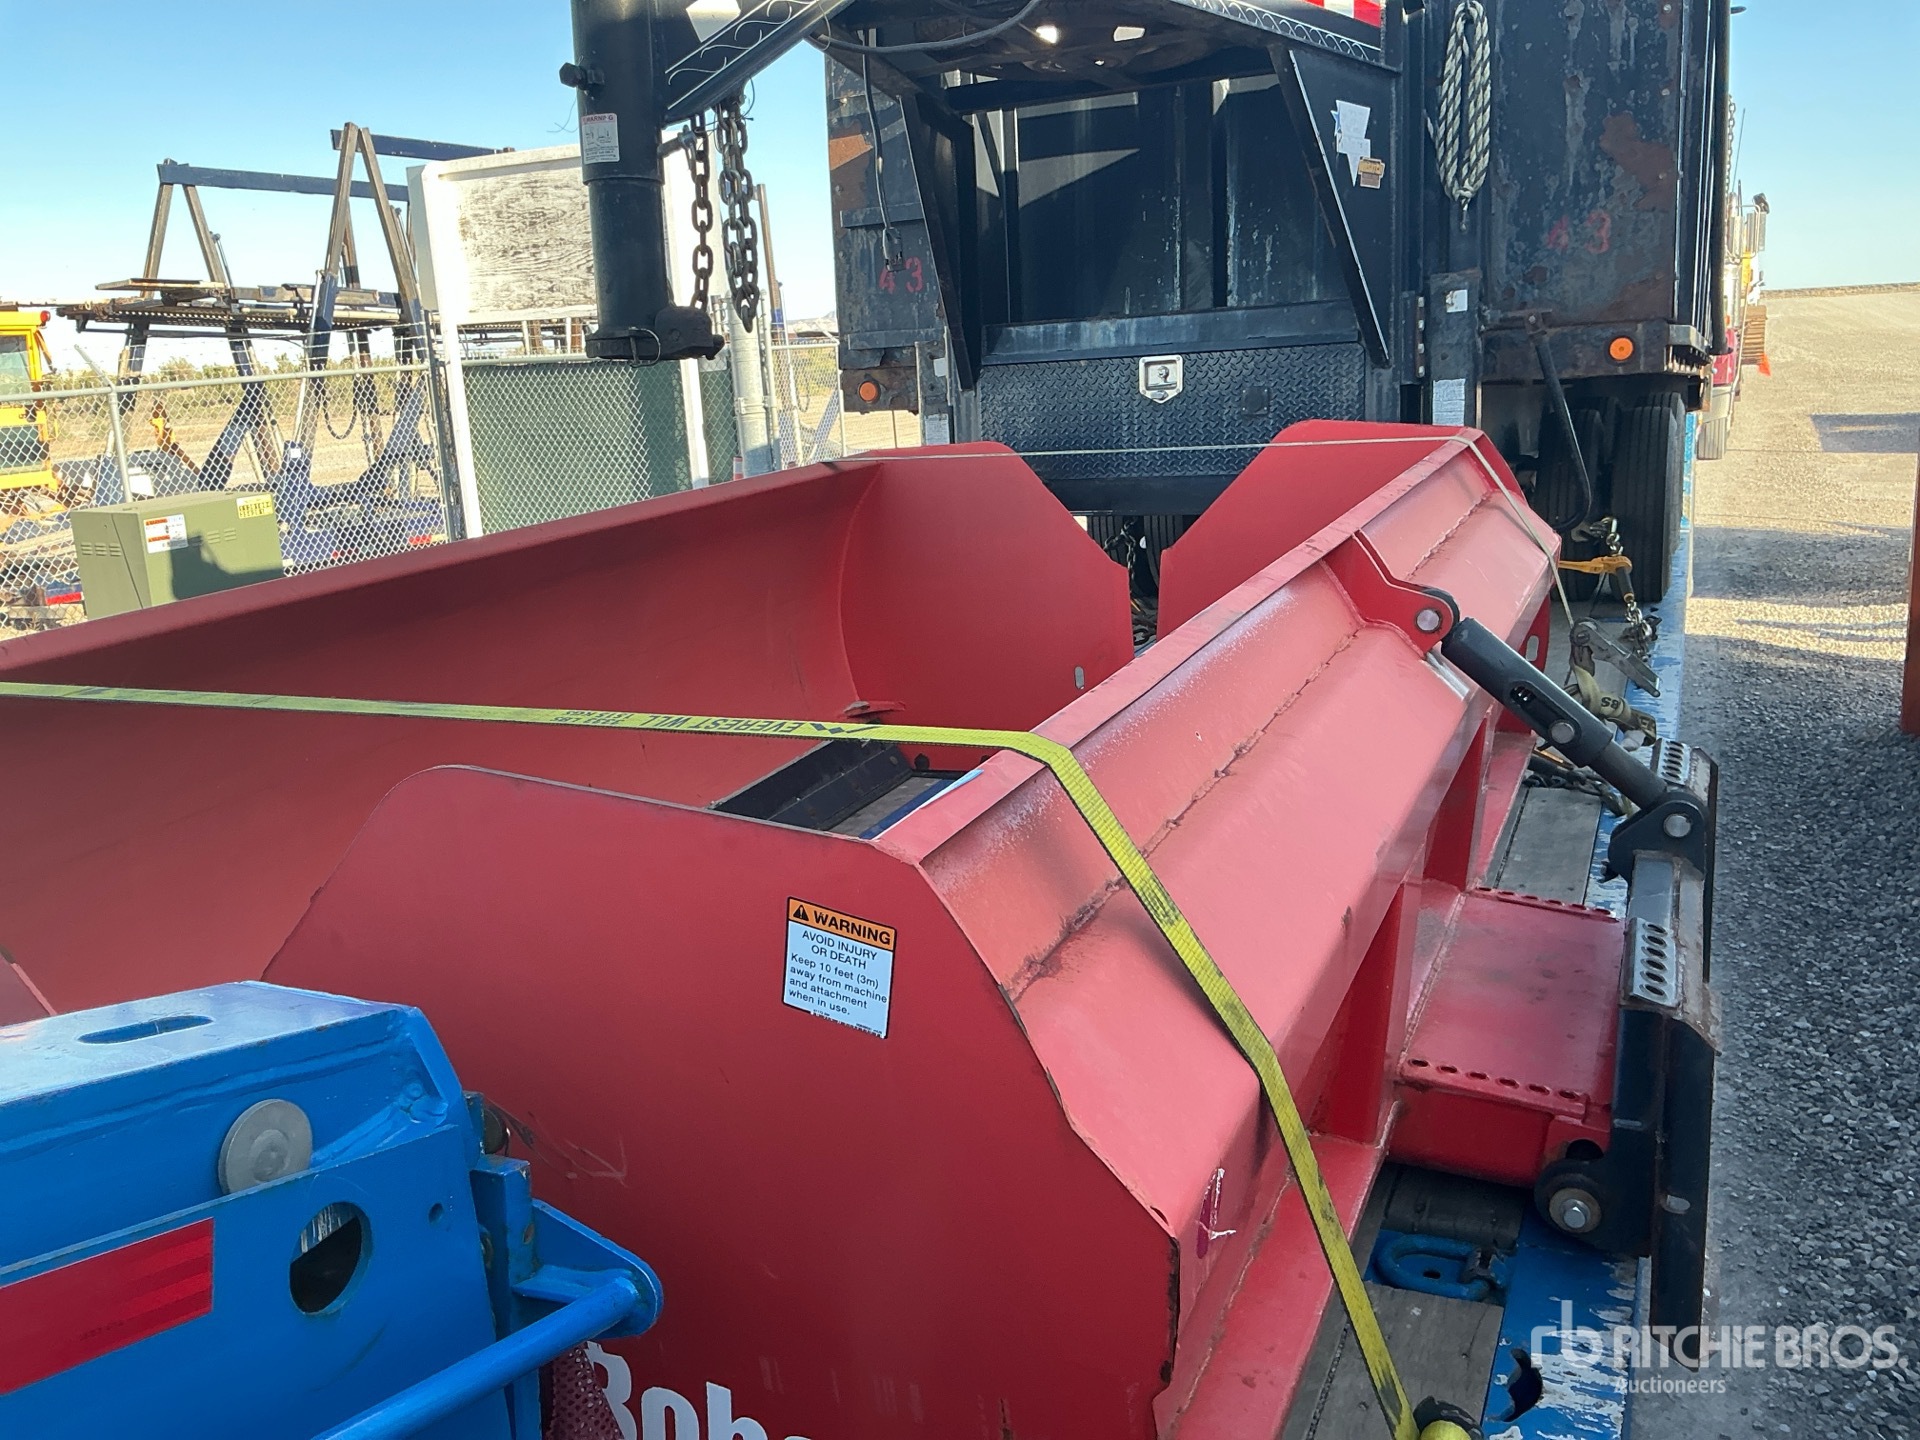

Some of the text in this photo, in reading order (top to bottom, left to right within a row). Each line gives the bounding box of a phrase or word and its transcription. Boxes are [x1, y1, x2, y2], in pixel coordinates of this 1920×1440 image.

[640, 715, 806, 733] EVEREST WLL
[814, 910, 891, 945] WARNING
[802, 930, 877, 960] AVOID INJURY
[811, 945, 866, 969] OR DEATH
[790, 966, 887, 1003] away from machine
[791, 953, 879, 989] Keep 10 feet (3m)
[789, 989, 814, 1003] when
[817, 997, 827, 1007] in
[829, 1003, 850, 1015] use.
[790, 978, 868, 1009] and attachment
[583, 1340, 814, 1440] Bob
